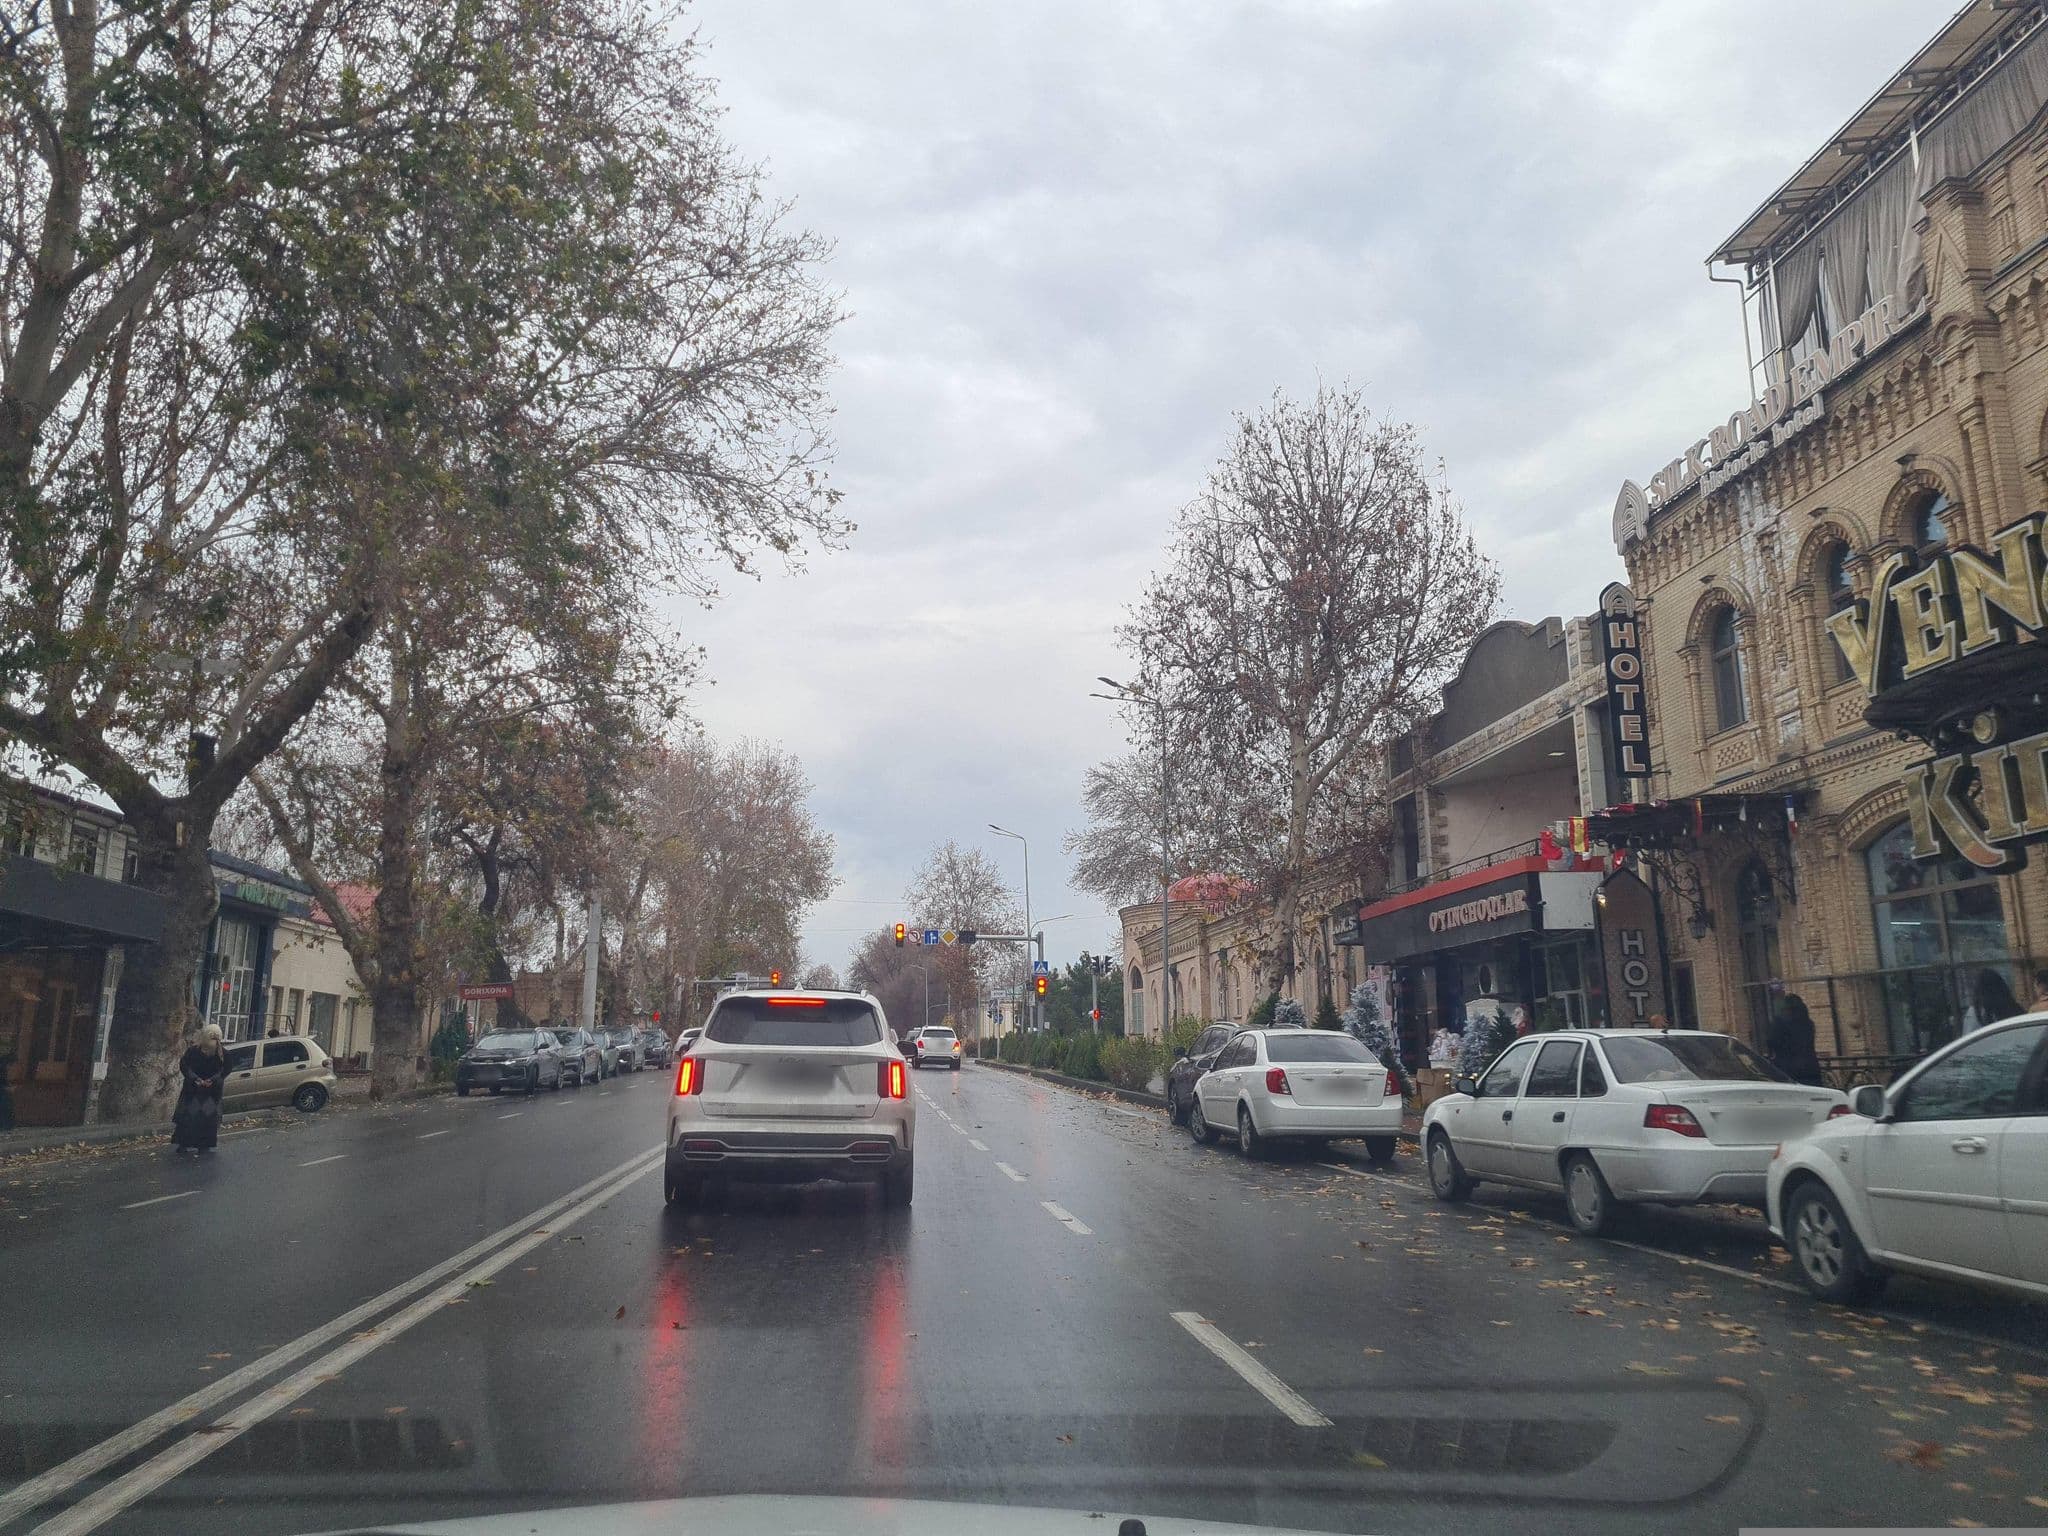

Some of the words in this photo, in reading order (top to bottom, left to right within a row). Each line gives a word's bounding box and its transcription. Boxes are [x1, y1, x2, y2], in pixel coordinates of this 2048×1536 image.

[1650, 438, 1709, 509] SILK
[1708, 380, 1788, 465] ROAD
[1700, 440, 1770, 499] historic
[1771, 392, 1826, 449] hotel
[1824, 516, 2048, 699] VEN
[1608, 622, 1647, 773] HOTEL
[464, 987, 507, 996] DORIXONA
[1621, 930, 1650, 1028] HOT
